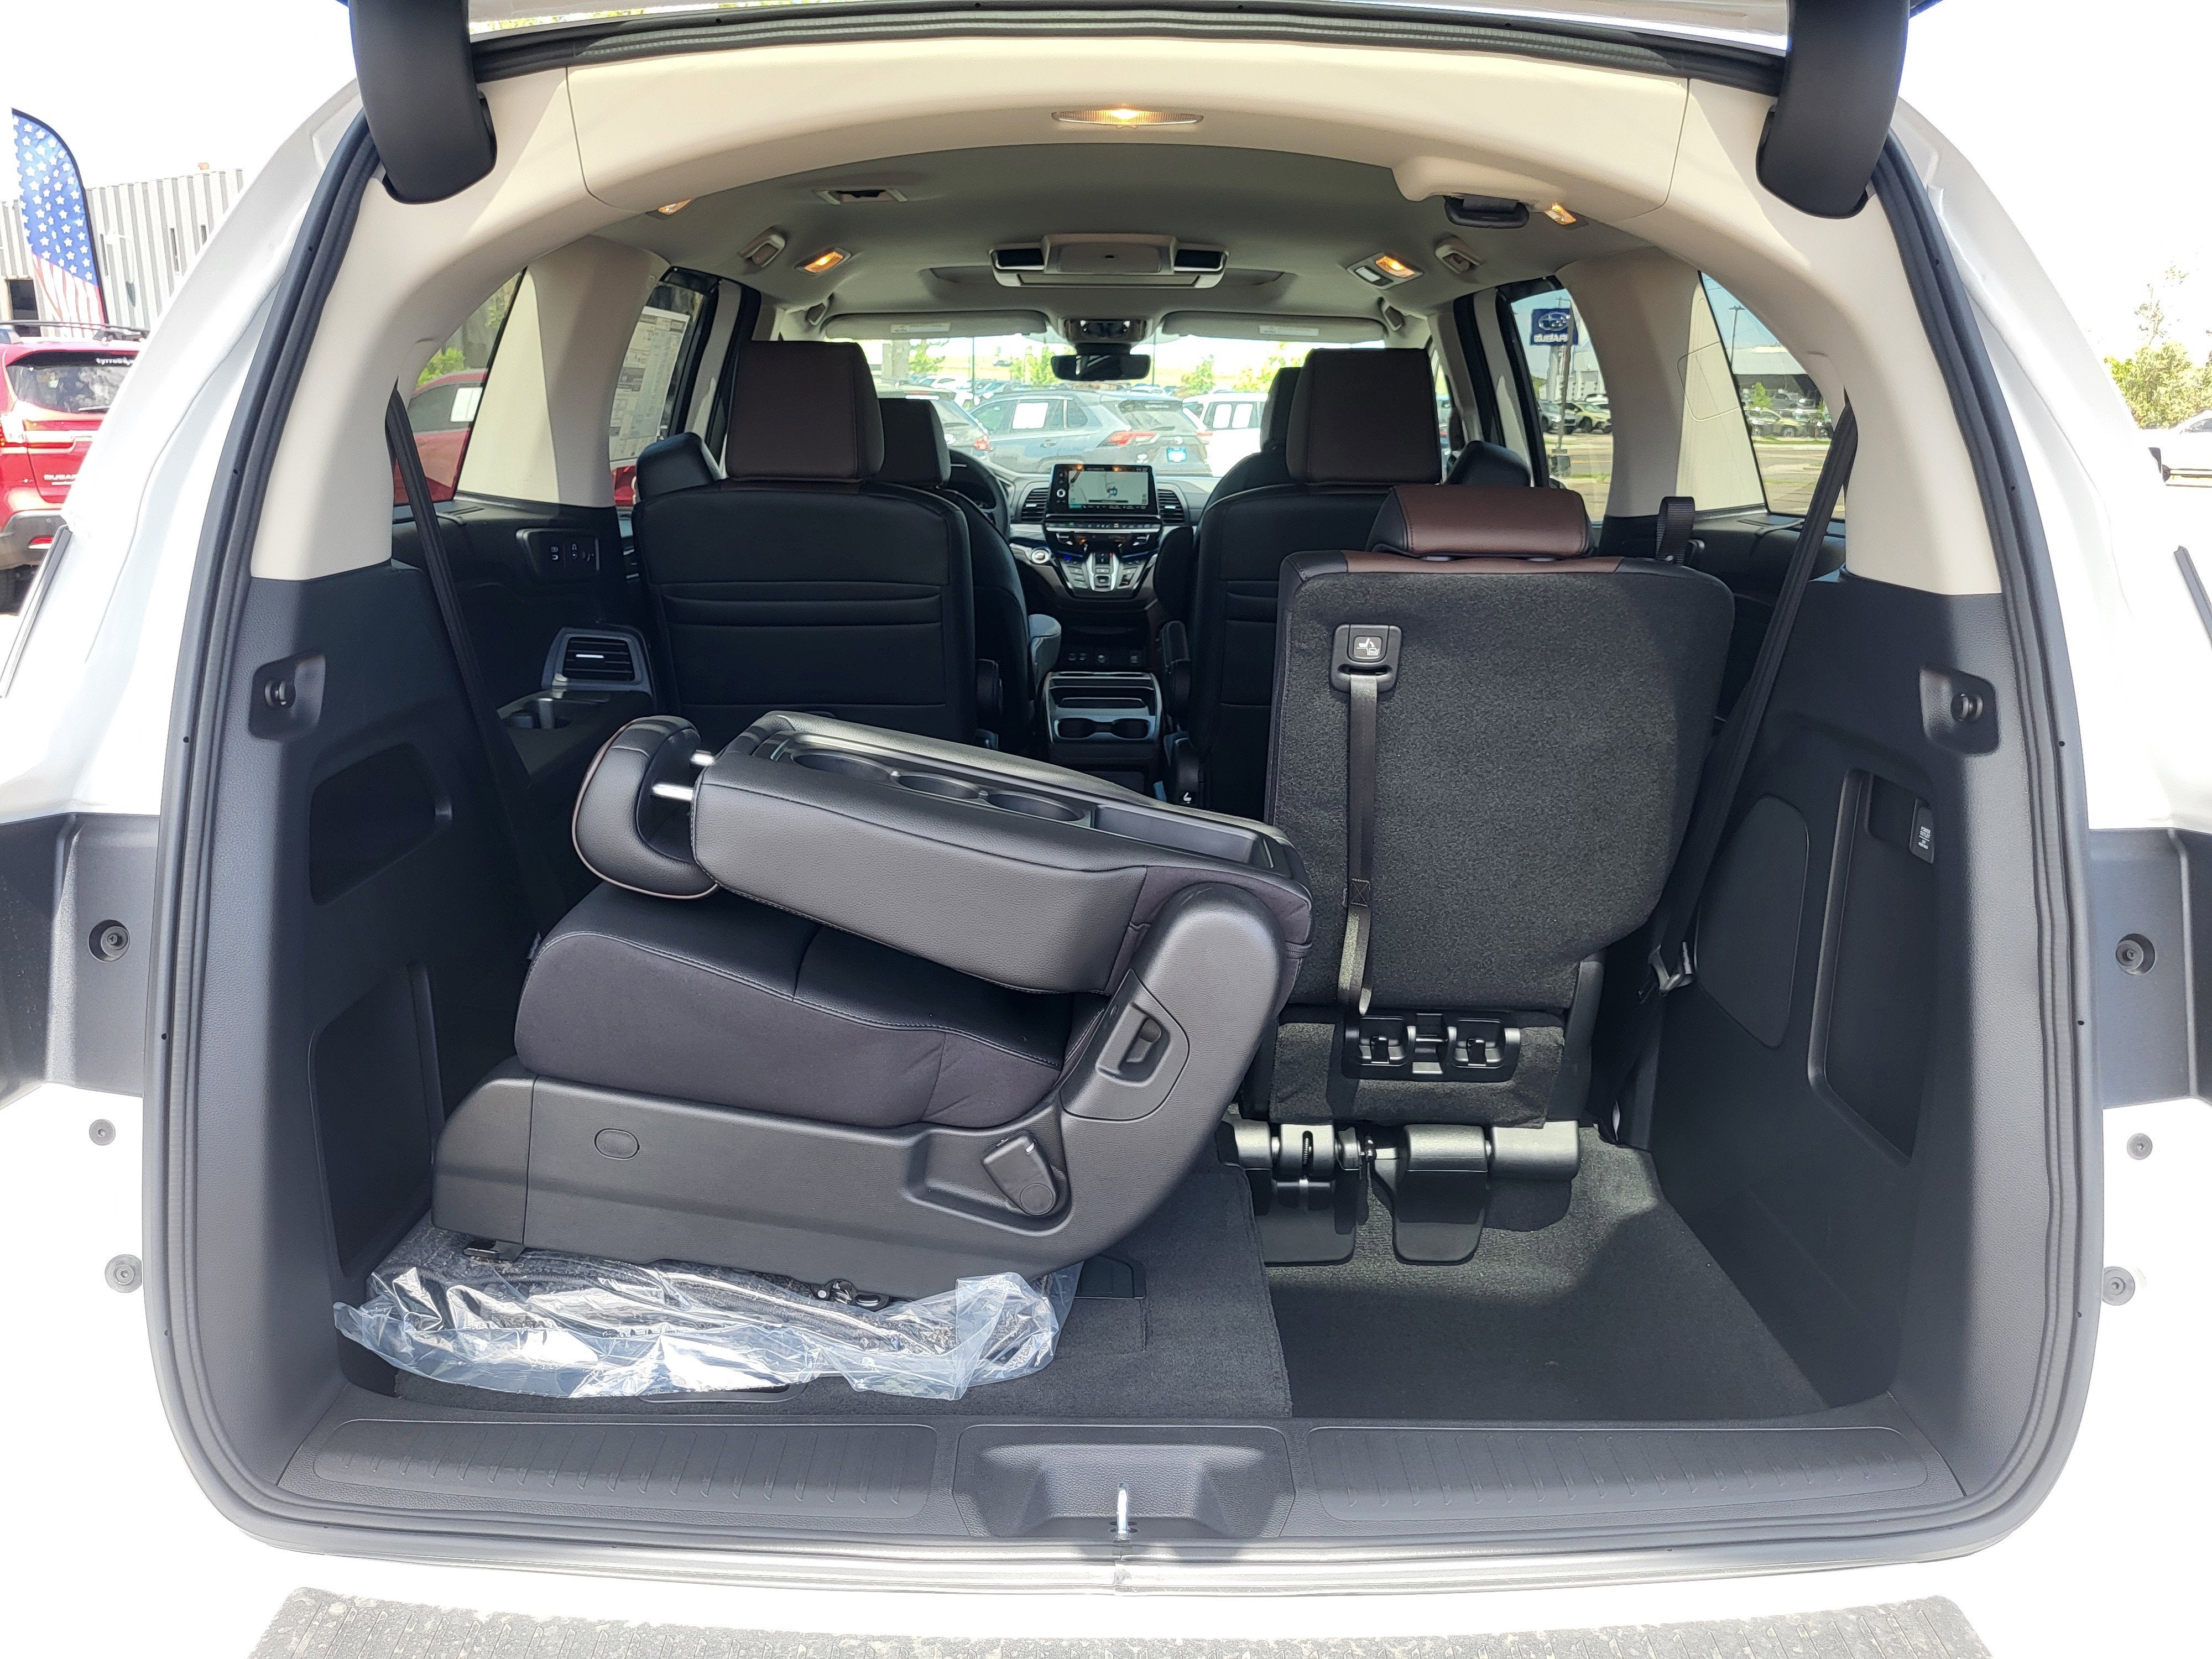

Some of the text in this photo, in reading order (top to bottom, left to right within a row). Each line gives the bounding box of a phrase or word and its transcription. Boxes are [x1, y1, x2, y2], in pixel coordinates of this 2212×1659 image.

[1533, 333, 1568, 343] SUBAR
[1919, 830, 1931, 839] OUTLET
[1921, 826, 1931, 834] POWER
